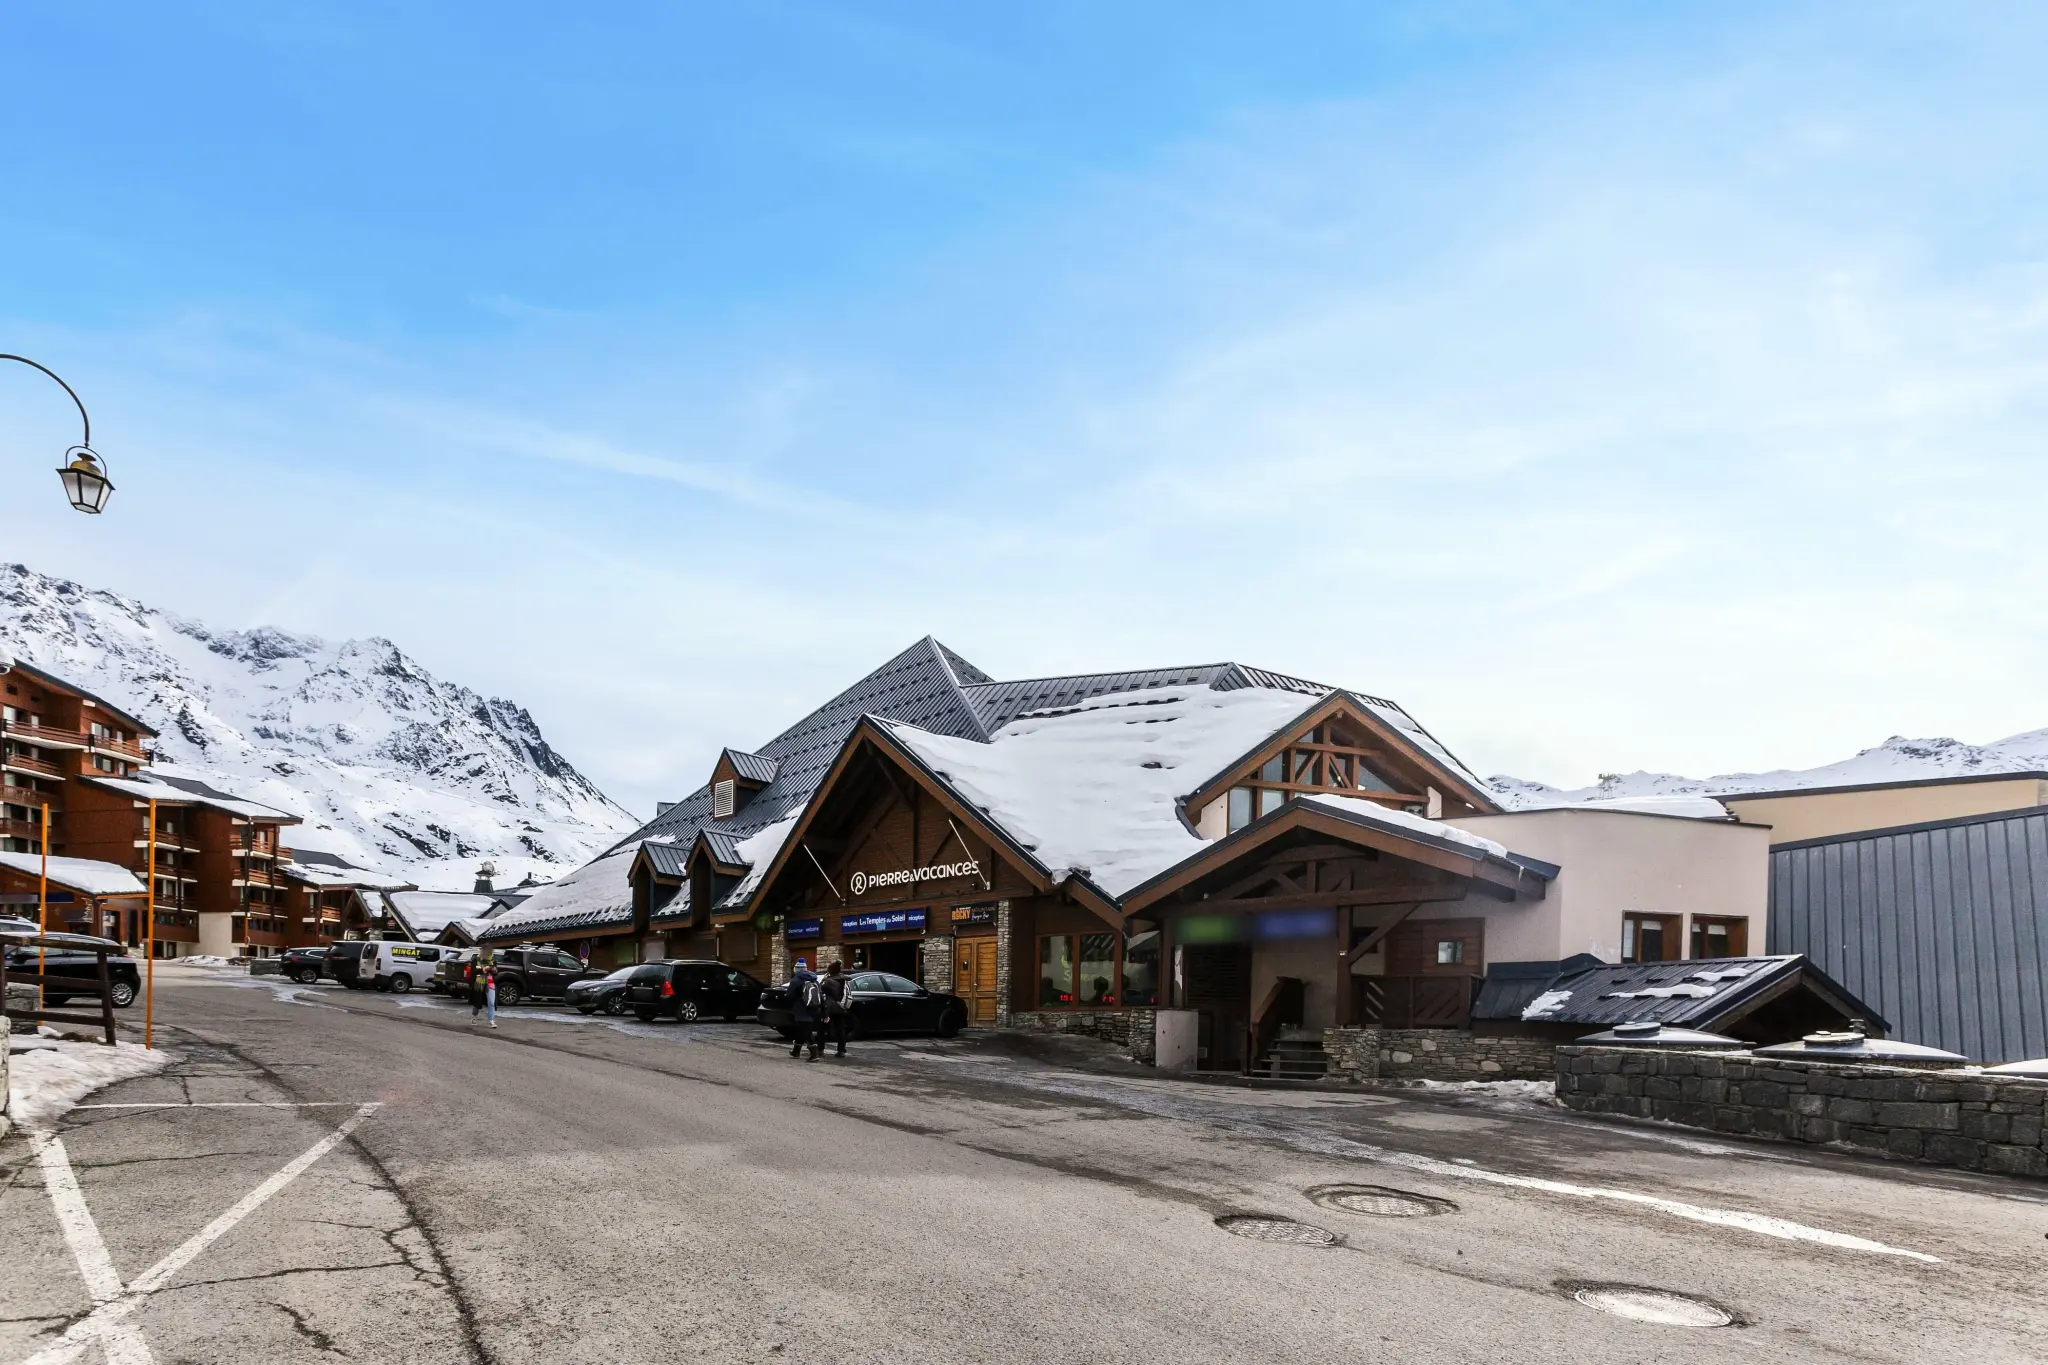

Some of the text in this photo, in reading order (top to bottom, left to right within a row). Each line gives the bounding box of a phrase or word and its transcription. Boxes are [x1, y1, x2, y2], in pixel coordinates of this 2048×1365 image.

[866, 916, 886, 925] Temples
[891, 914, 906, 923] Soleil
[951, 908, 971, 921] ROCKY
[392, 948, 421, 956] MINGAT
